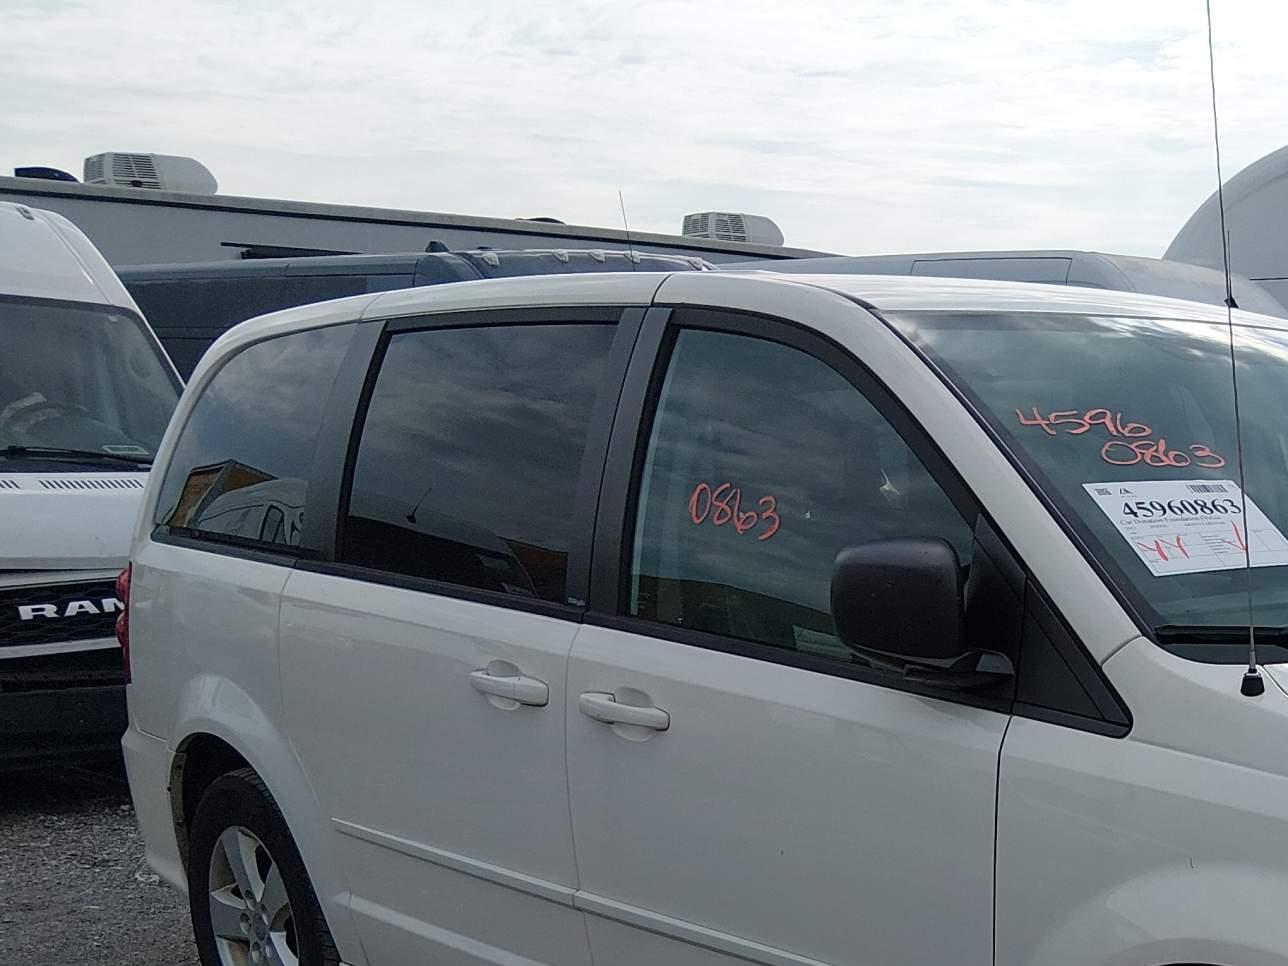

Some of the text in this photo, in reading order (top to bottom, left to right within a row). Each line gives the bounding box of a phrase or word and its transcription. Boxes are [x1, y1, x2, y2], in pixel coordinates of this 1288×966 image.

[1015, 407, 1152, 436] 4596
[1101, 438, 1225, 468] 0863
[688, 482, 781, 540] 0863
[1122, 498, 1242, 518] 45960863
